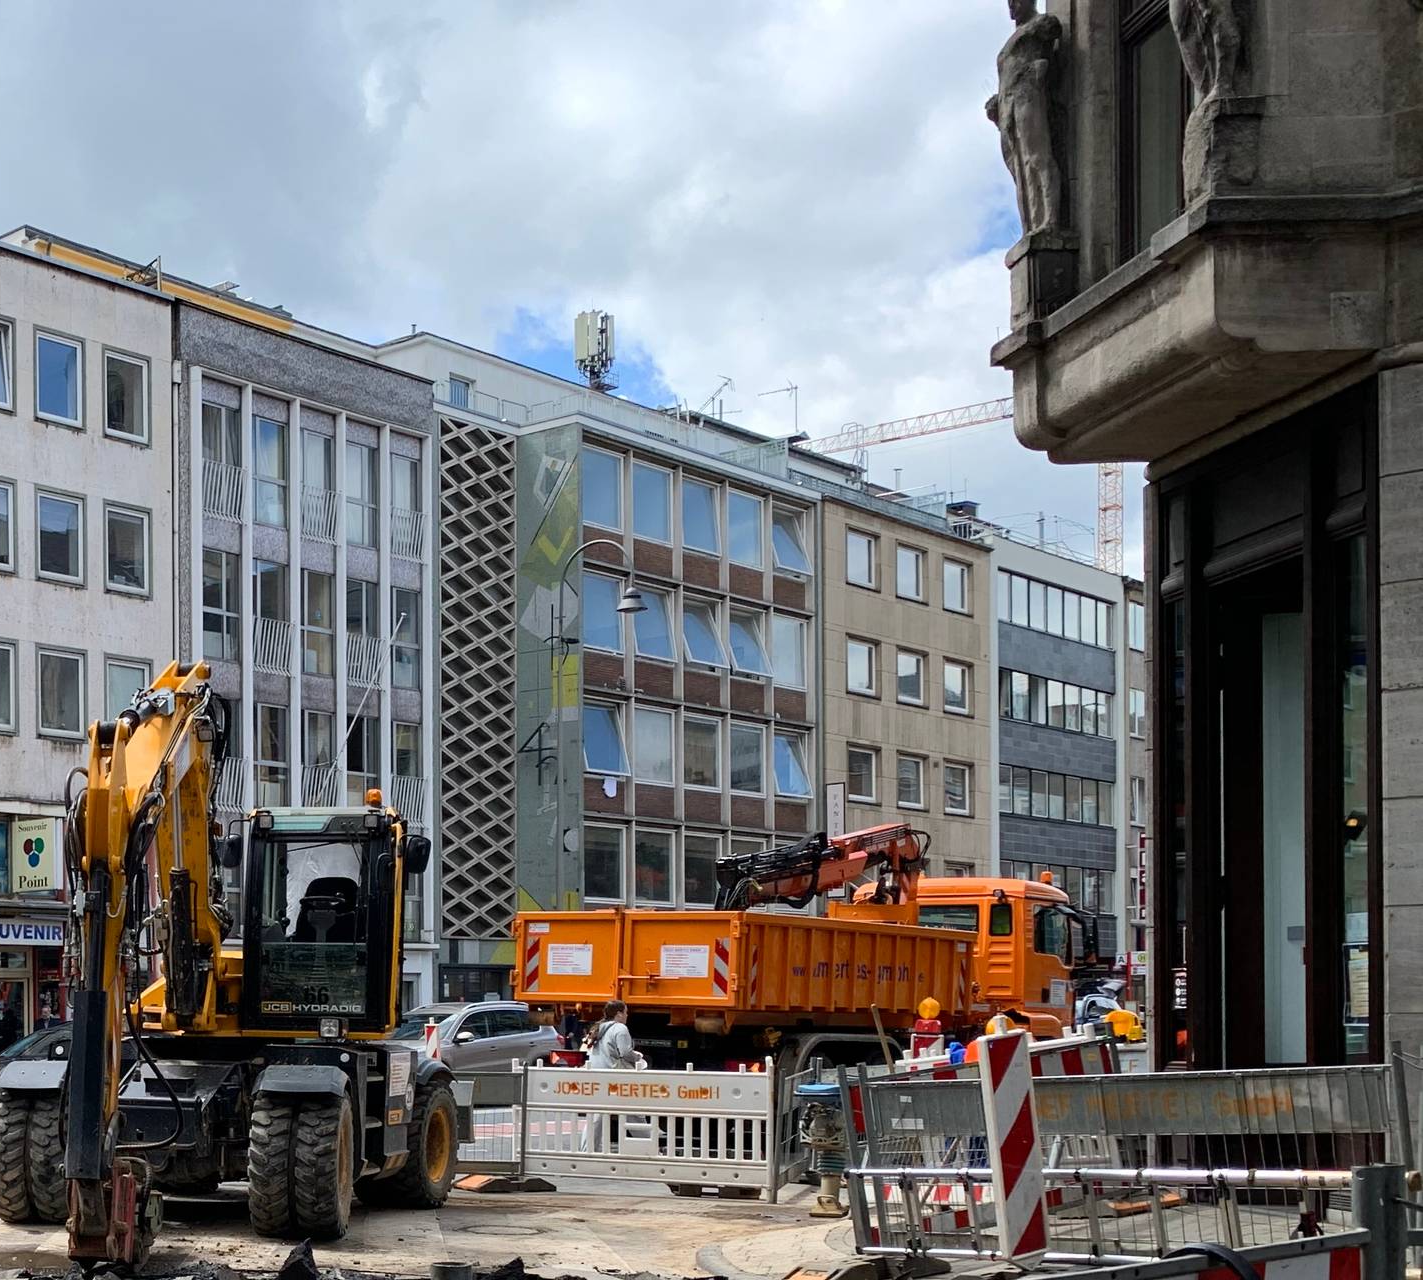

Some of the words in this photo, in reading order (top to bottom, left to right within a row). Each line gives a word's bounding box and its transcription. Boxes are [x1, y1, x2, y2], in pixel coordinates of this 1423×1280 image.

[18, 822, 47, 832] Souvenir
[18, 875, 48, 889] Point
[263, 1004, 291, 1012] JCB
[293, 1004, 362, 1013] HYDRADIG
[553, 1080, 601, 1097] JOSEF
[607, 1082, 670, 1099] MERTES
[677, 1084, 721, 1101] GmbH
